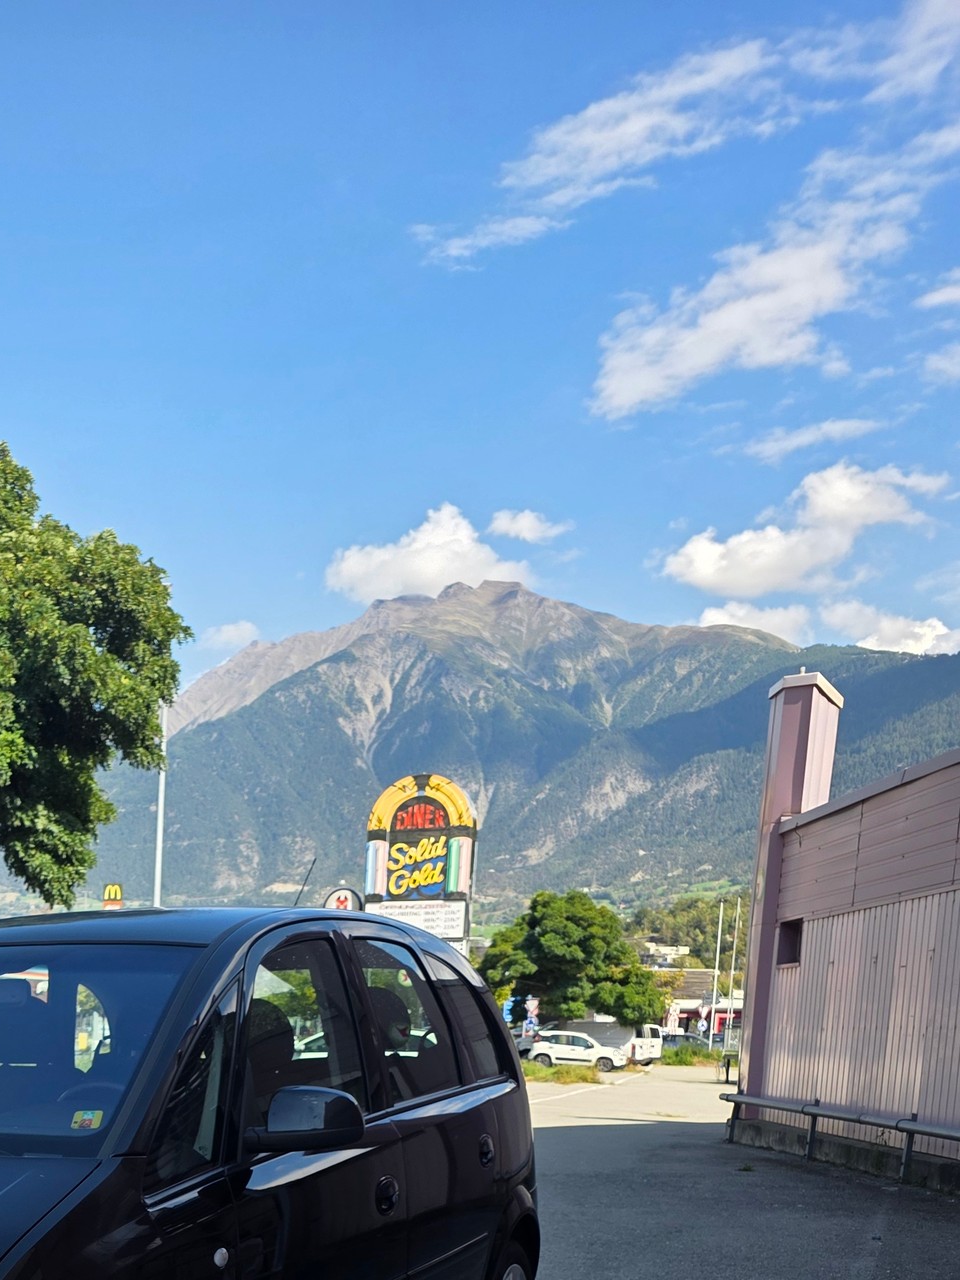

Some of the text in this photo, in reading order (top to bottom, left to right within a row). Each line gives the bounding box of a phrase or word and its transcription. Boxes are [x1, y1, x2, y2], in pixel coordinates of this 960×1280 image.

[397, 804, 445, 829] DINER
[387, 836, 448, 871] Solid
[388, 862, 445, 895] Gold
